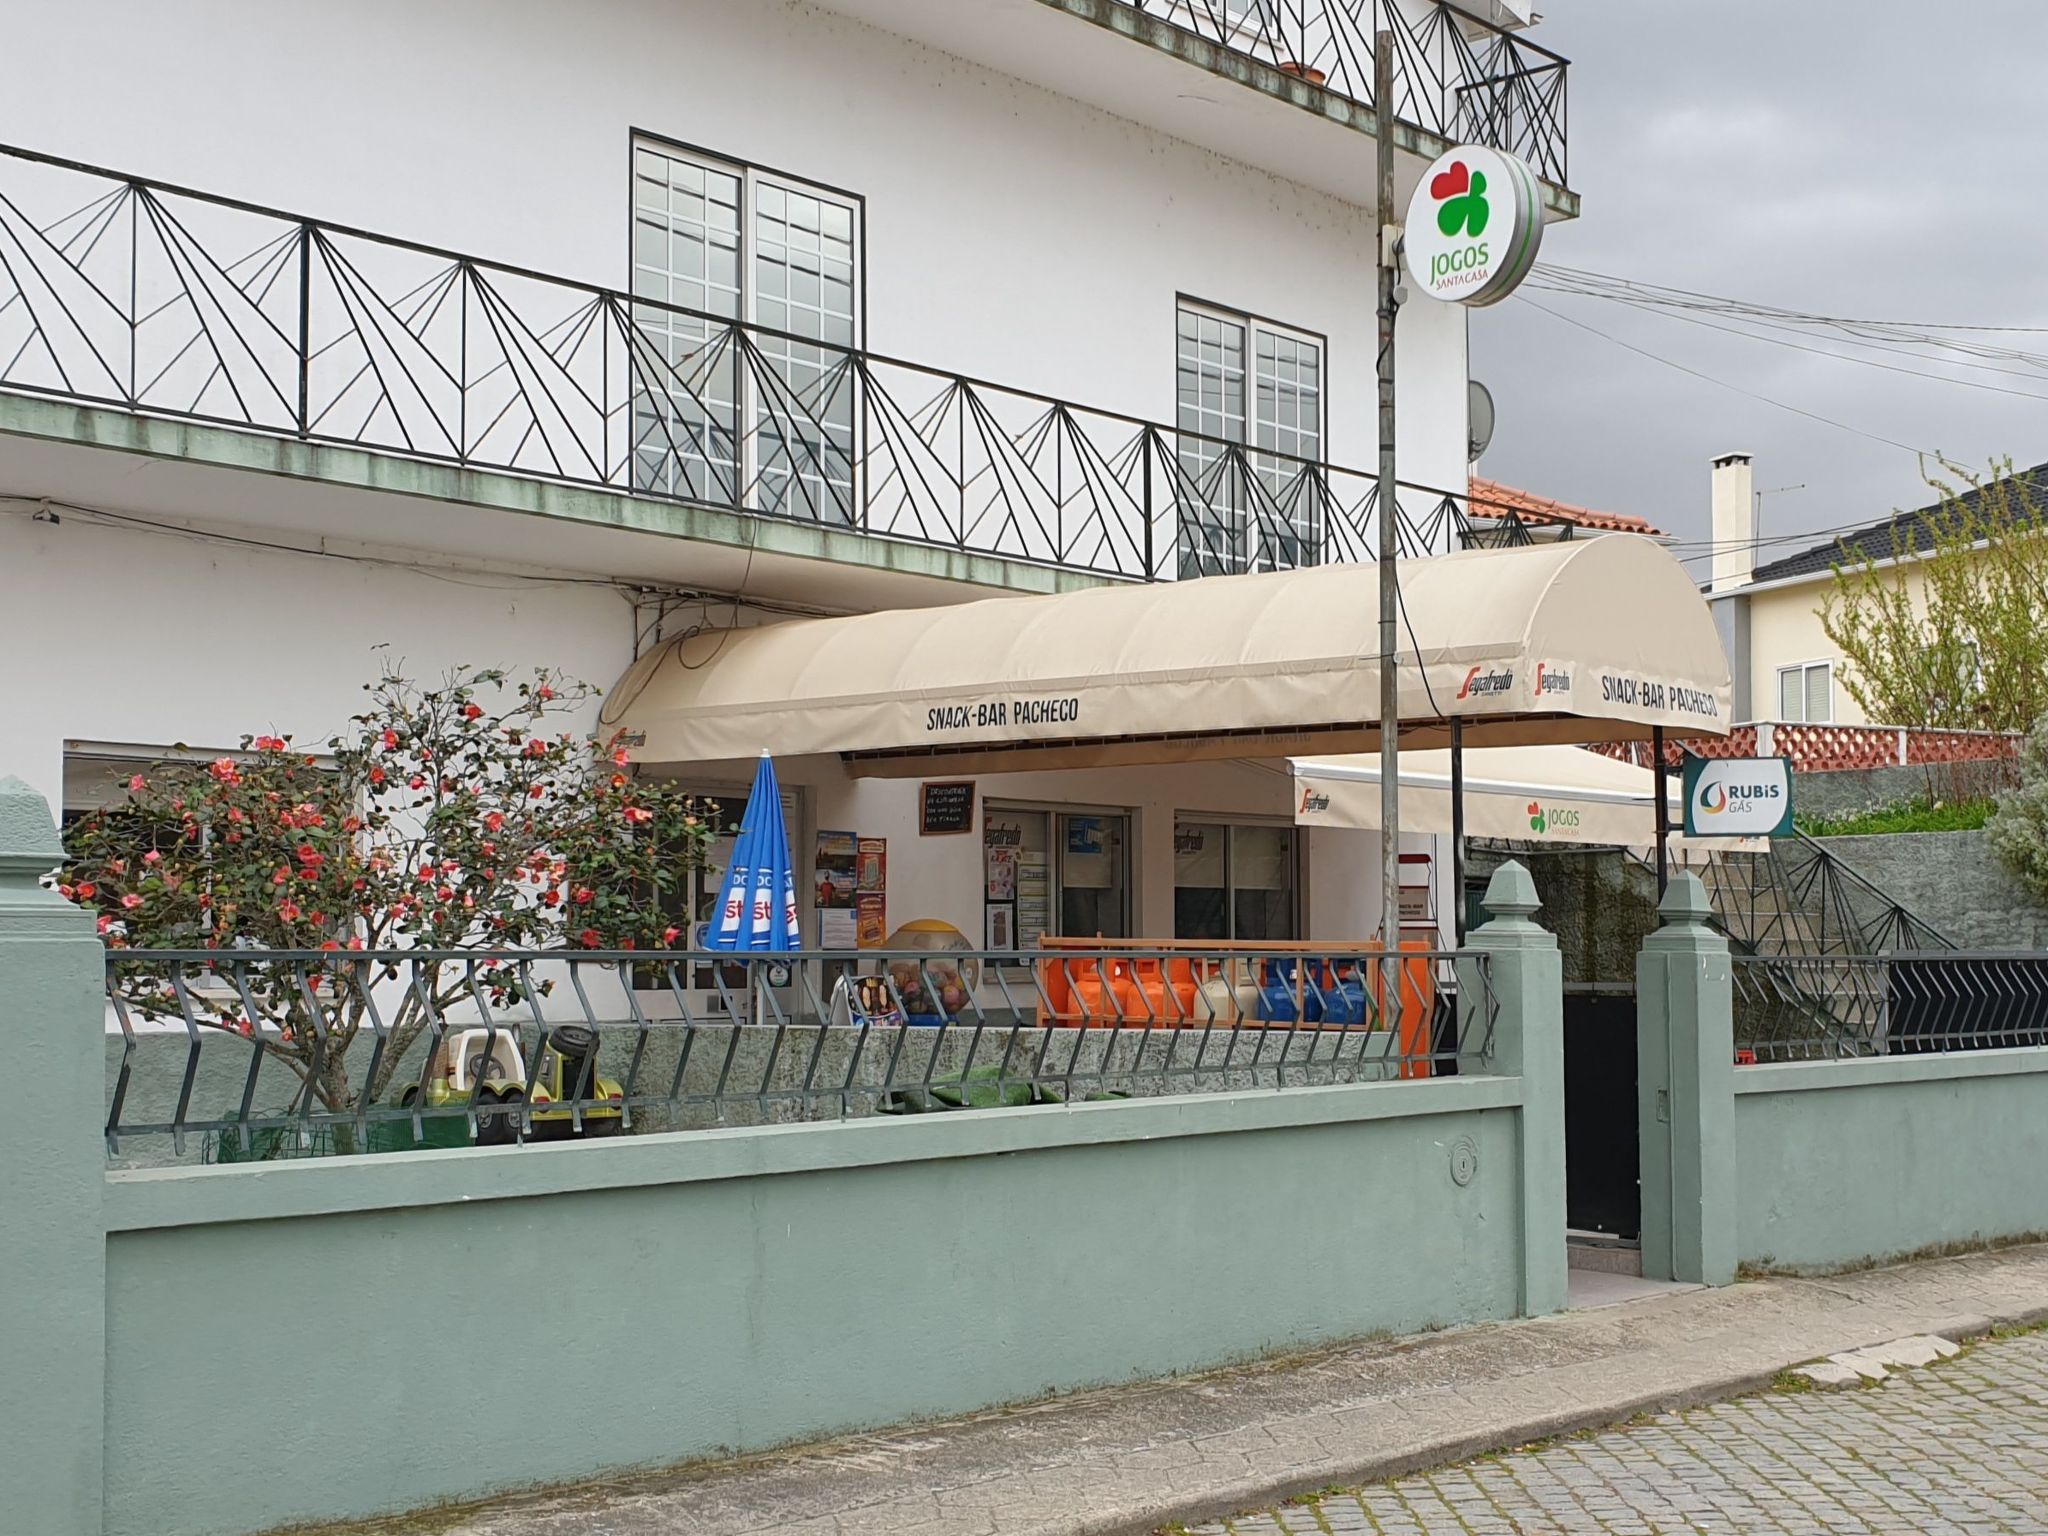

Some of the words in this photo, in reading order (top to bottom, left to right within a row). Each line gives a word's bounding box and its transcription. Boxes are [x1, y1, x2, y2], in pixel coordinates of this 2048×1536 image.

[1430, 243, 1488, 286] JOGOS
[1601, 675, 1665, 710] SNACK-BAR
[1668, 686, 1718, 717] PACHECO
[927, 703, 1007, 731] SNACK-BAR
[1014, 698, 1079, 725] PACHECO
[1547, 808, 1580, 829] JOGOS
[1728, 800, 1753, 813] GÁS
